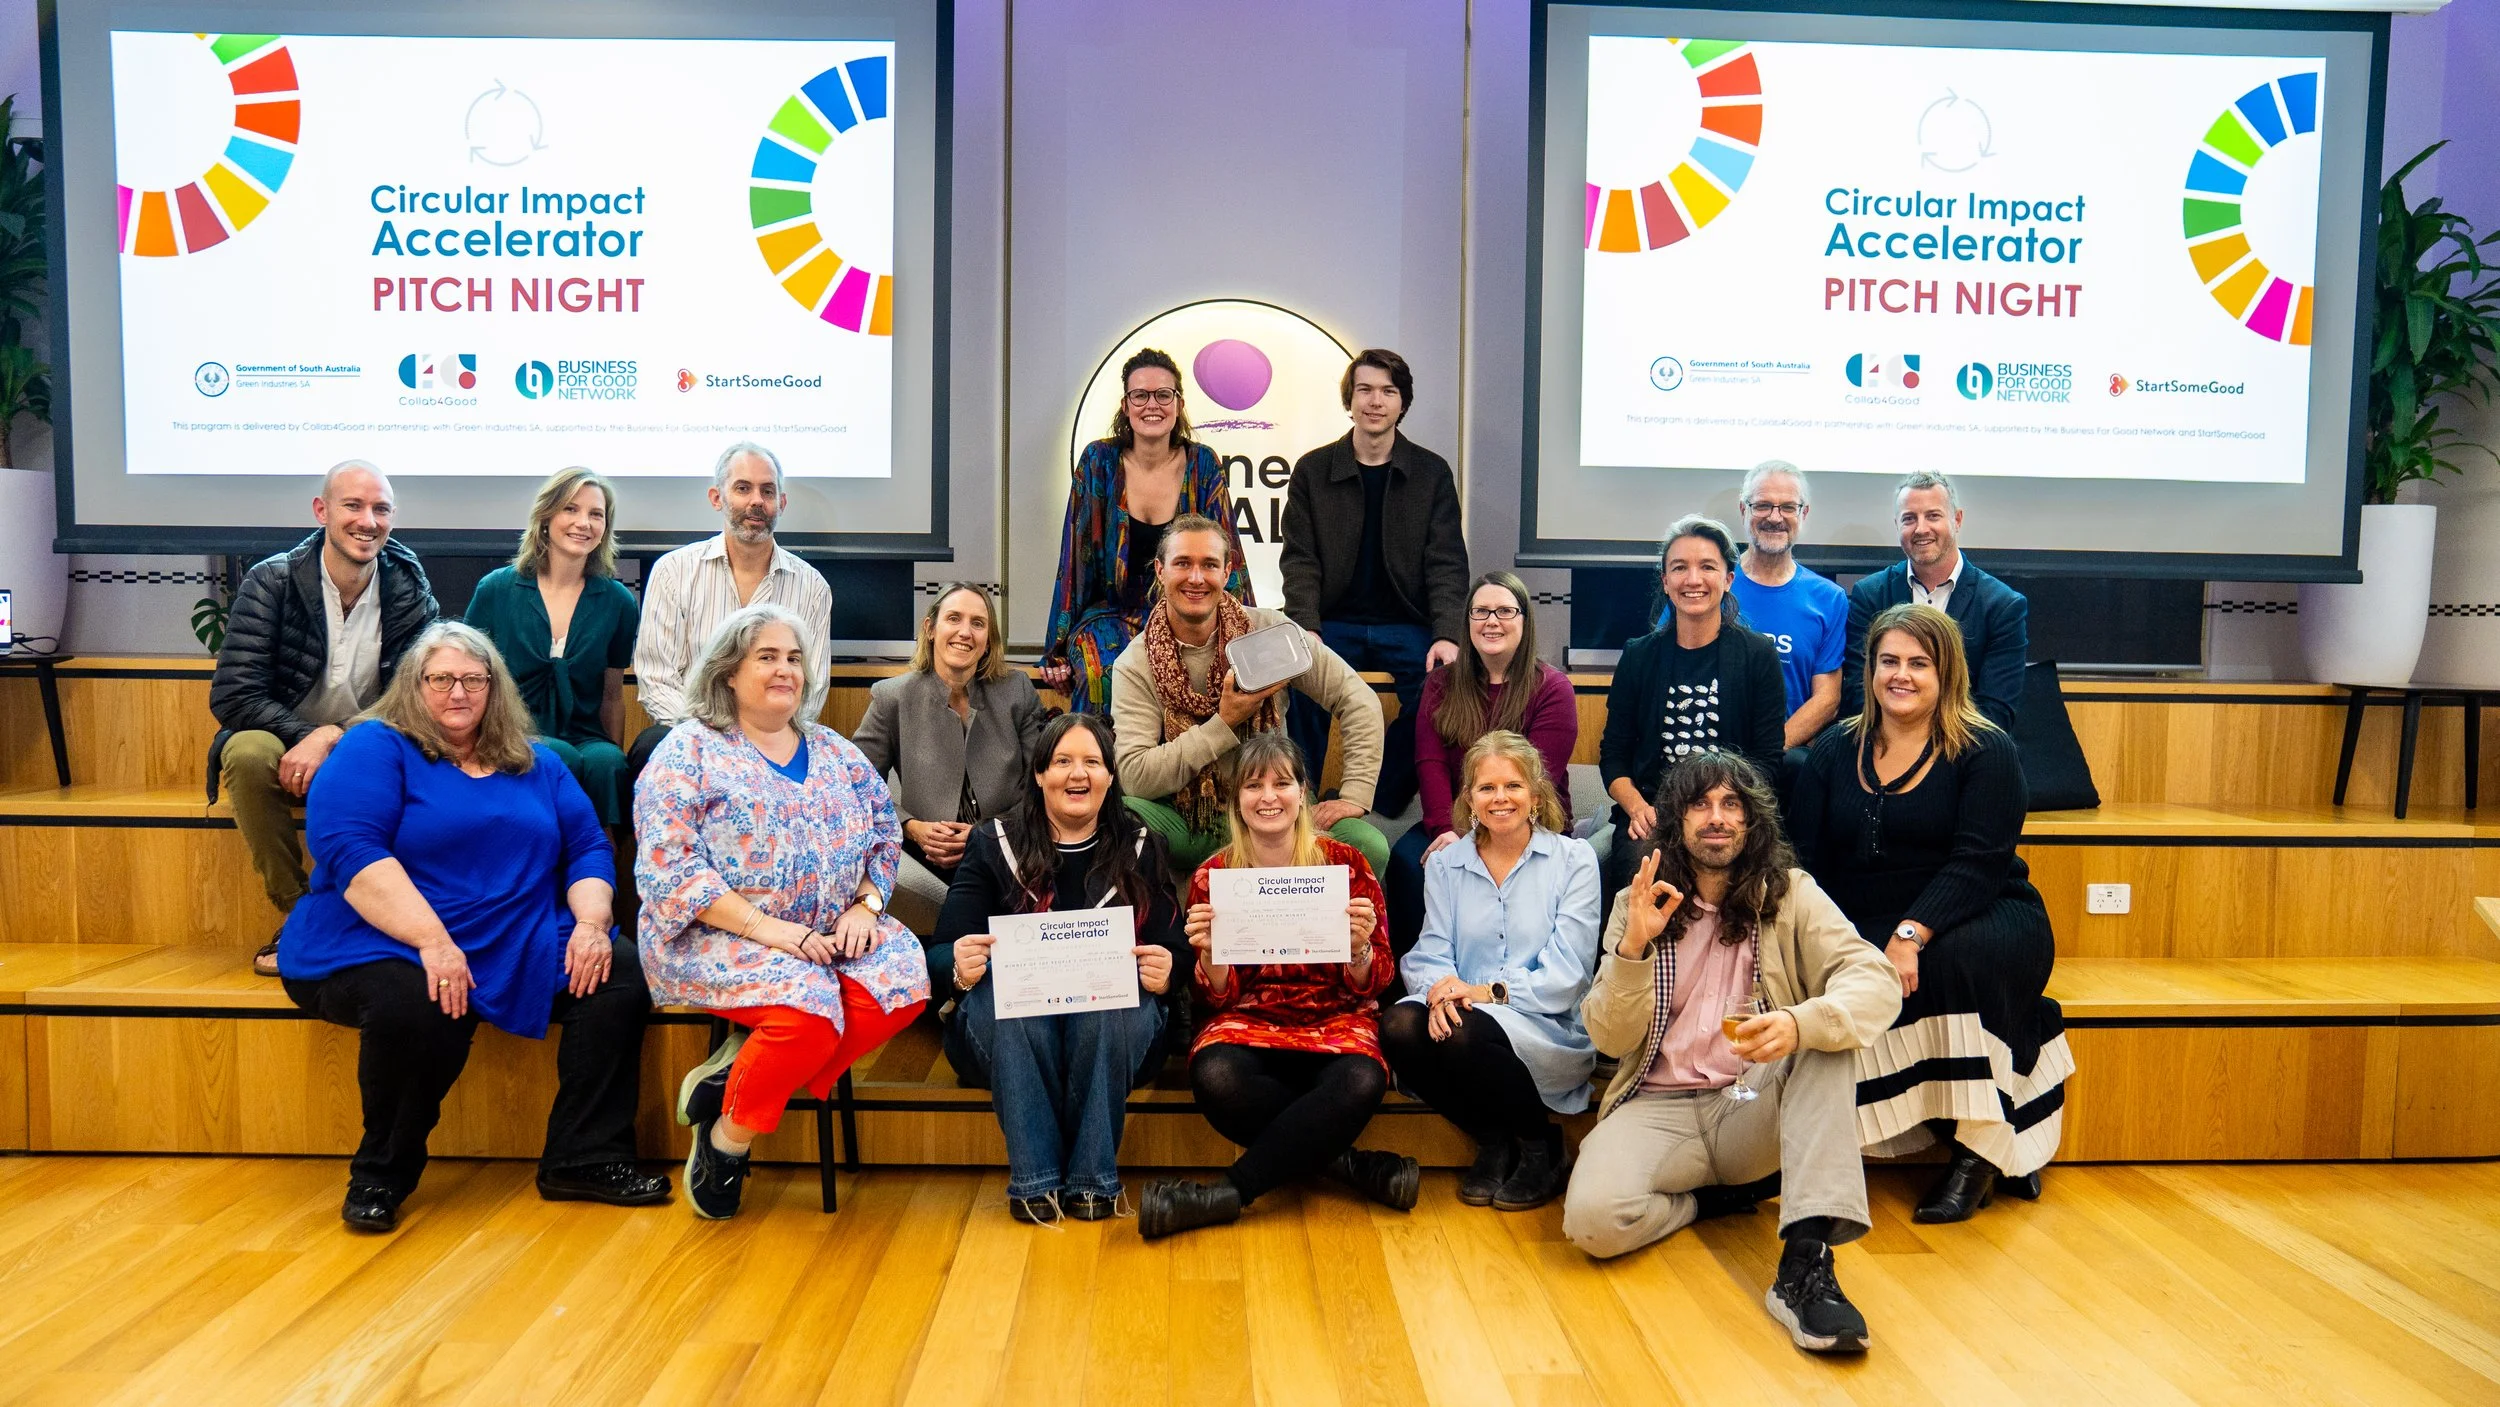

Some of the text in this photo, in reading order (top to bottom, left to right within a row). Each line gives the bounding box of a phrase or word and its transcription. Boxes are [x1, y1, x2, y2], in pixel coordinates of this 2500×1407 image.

[371, 185, 646, 220] Circular Impact
[1825, 188, 2085, 227] Circular Impact
[371, 220, 643, 257] Accelerator
[1824, 222, 2083, 264] Accelerator
[373, 277, 645, 312] PITCH NIGHT
[1825, 277, 2083, 317] PITCH NIGHT
[235, 364, 361, 373] Government of South Australia
[558, 360, 637, 374] BUSINESS
[1689, 359, 1811, 370] Government of South Australia
[1999, 363, 2072, 377] BUSINESS
[235, 380, 310, 388] Green Industries SA
[558, 375, 637, 387] FOR GOOD
[706, 374, 822, 387] StartSomeGood
[1998, 377, 2072, 390] FOR GOOD
[2136, 379, 2244, 395] StartSomeGood
[558, 388, 636, 400] NETWORK
[1845, 394, 1920, 405] Collab4Good
[1997, 389, 2071, 403] NETWORK
[399, 397, 477, 406] Collab4Good
[172, 421, 847, 434] This program is delivered by Collab4Good in partnership with Green Industries SA, supported by the Business For Good Network and StartSomeGood
[1258, 876, 1325, 887] Circular Impact
[1258, 885, 1325, 895] Accelerator
[1039, 918, 1109, 931] Circular Impact
[1041, 928, 1109, 941] Accelerator
